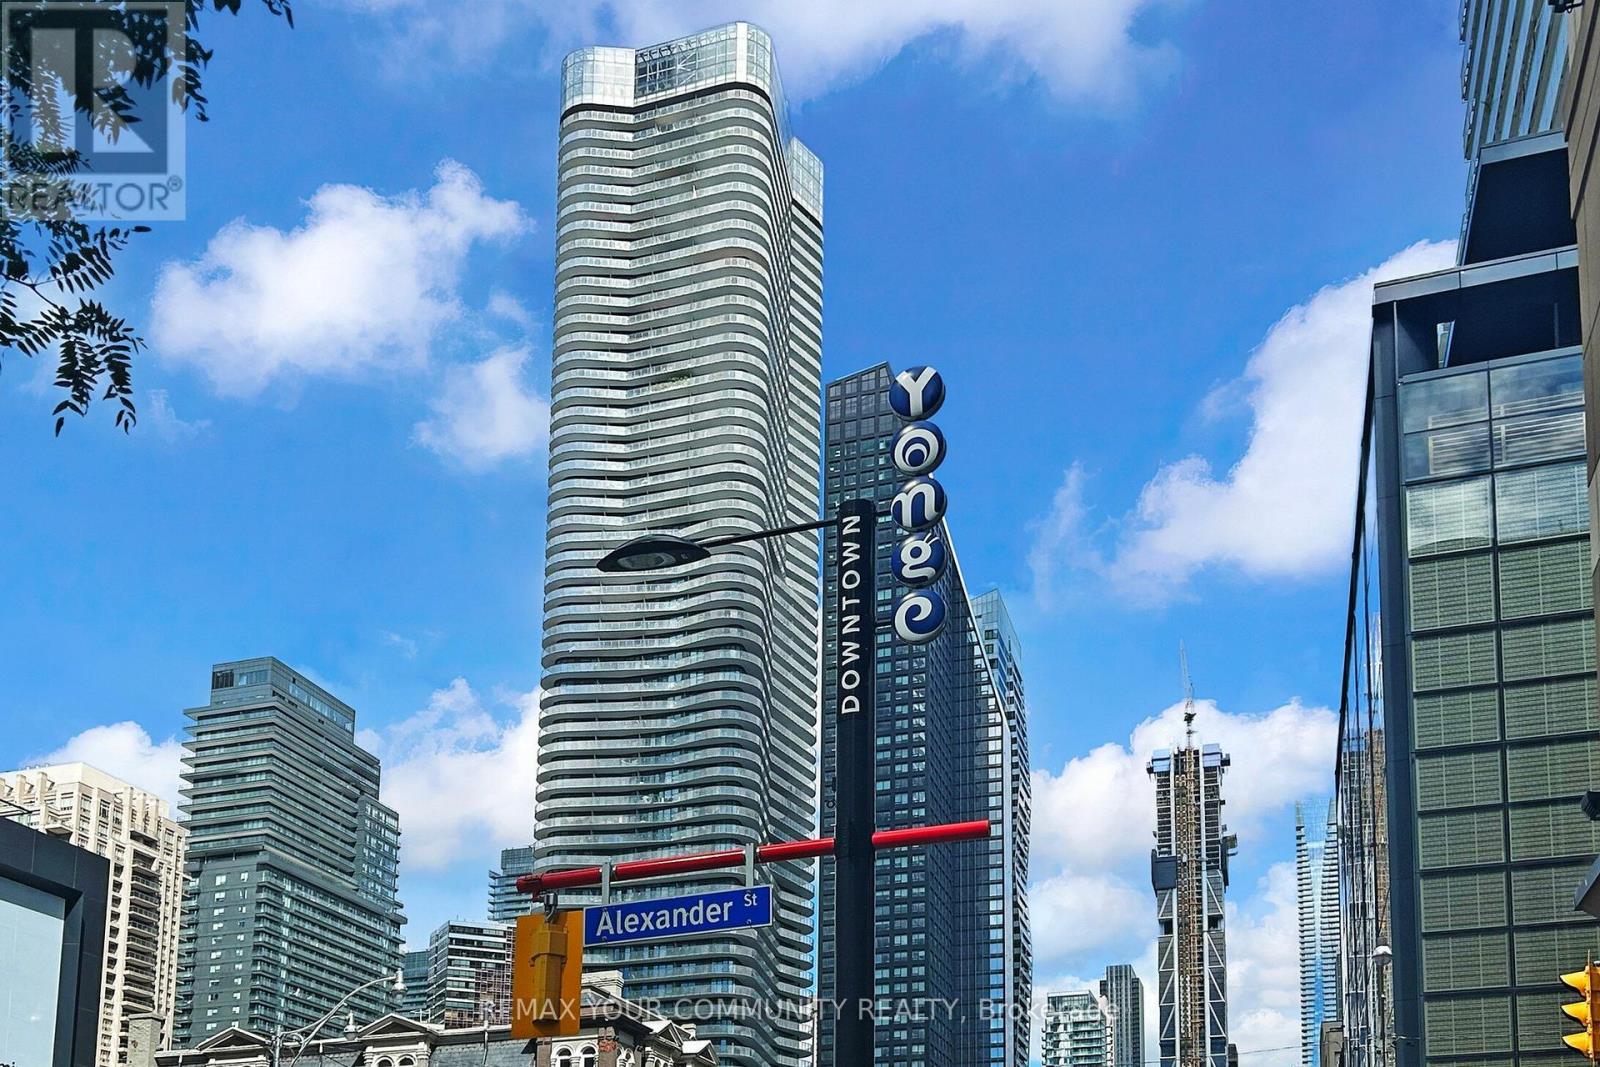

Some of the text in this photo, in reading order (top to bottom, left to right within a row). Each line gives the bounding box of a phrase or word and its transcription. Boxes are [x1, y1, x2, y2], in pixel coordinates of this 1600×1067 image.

[891, 366, 939, 642] Yonge
[841, 515, 861, 714] DOWNTOWN
[596, 893, 757, 936] Alexander St
